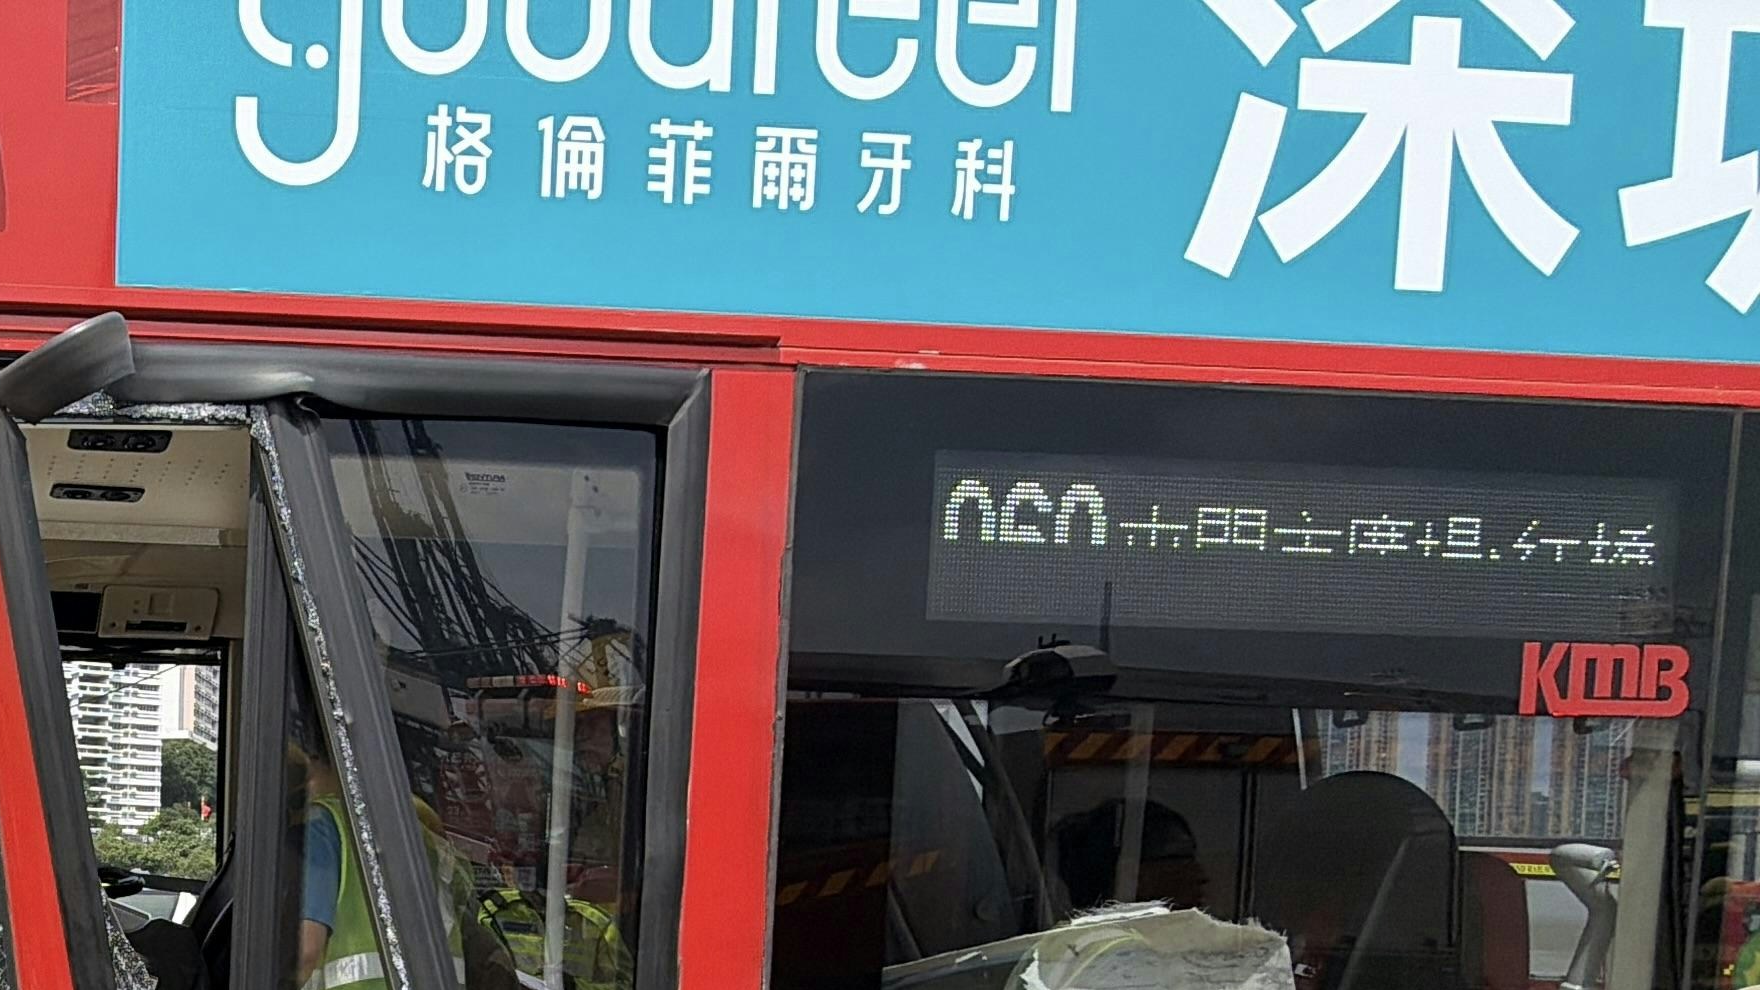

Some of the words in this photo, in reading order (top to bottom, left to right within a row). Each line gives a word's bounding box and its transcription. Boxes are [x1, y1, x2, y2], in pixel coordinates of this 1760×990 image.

[421, 104, 1018, 222] 格倫菲爾牙科
[1519, 642, 1690, 718] KMB
